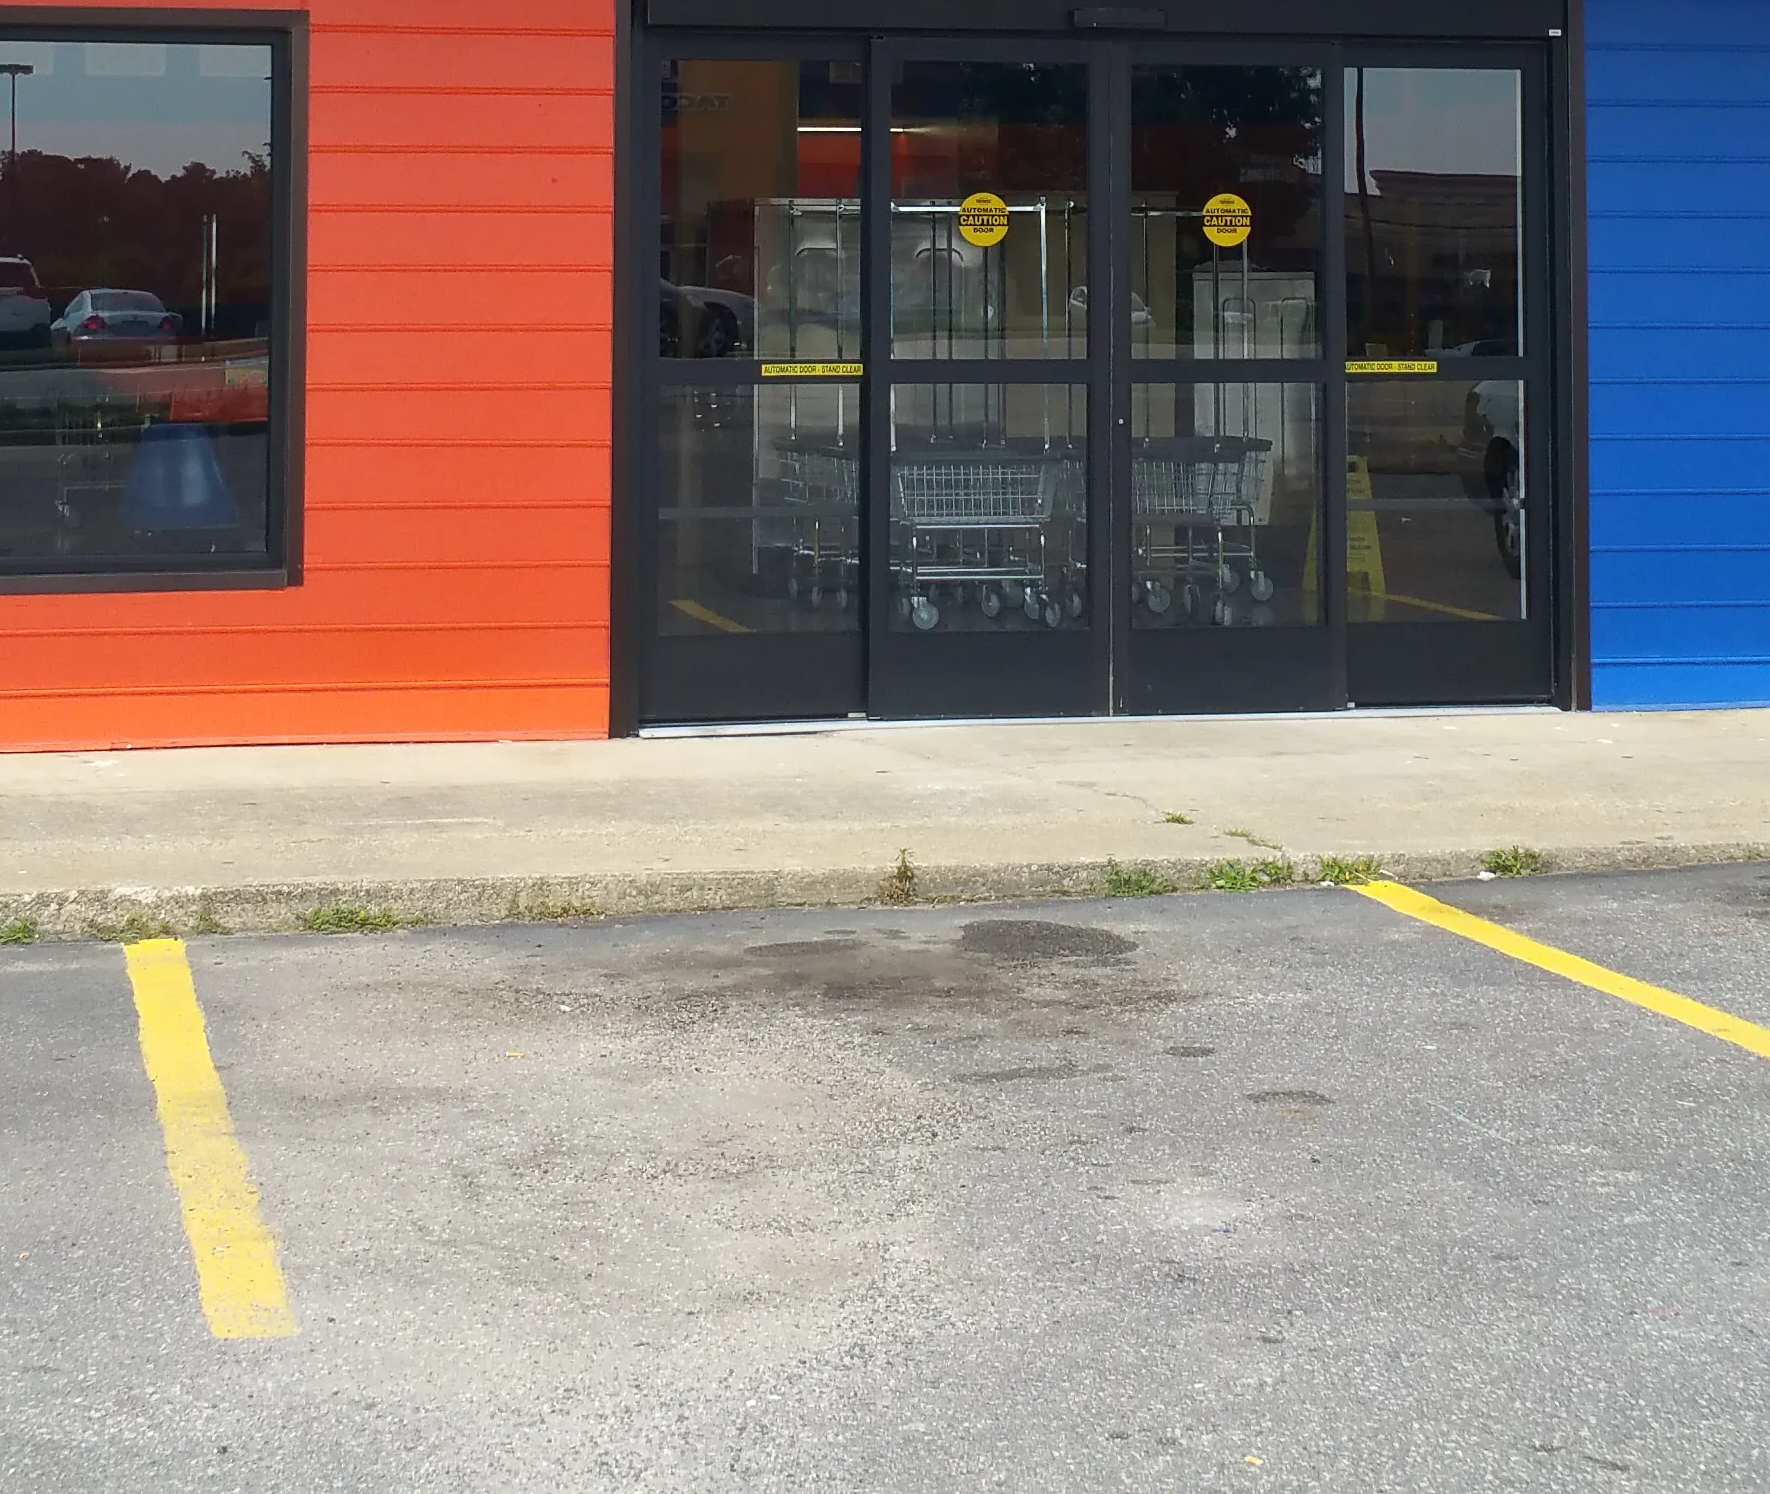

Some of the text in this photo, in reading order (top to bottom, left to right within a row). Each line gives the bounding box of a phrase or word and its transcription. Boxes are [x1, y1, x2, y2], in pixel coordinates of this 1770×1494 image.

[960, 215, 1008, 226] CAUTION
[1203, 216, 1250, 226] CAUTION
[764, 365, 862, 374] AUTOMATIC DOOR STAND CLEAR
[1376, 362, 1393, 371] DOOR
[1397, 362, 1416, 371] STAND
[1416, 362, 1435, 371] CLEAR
